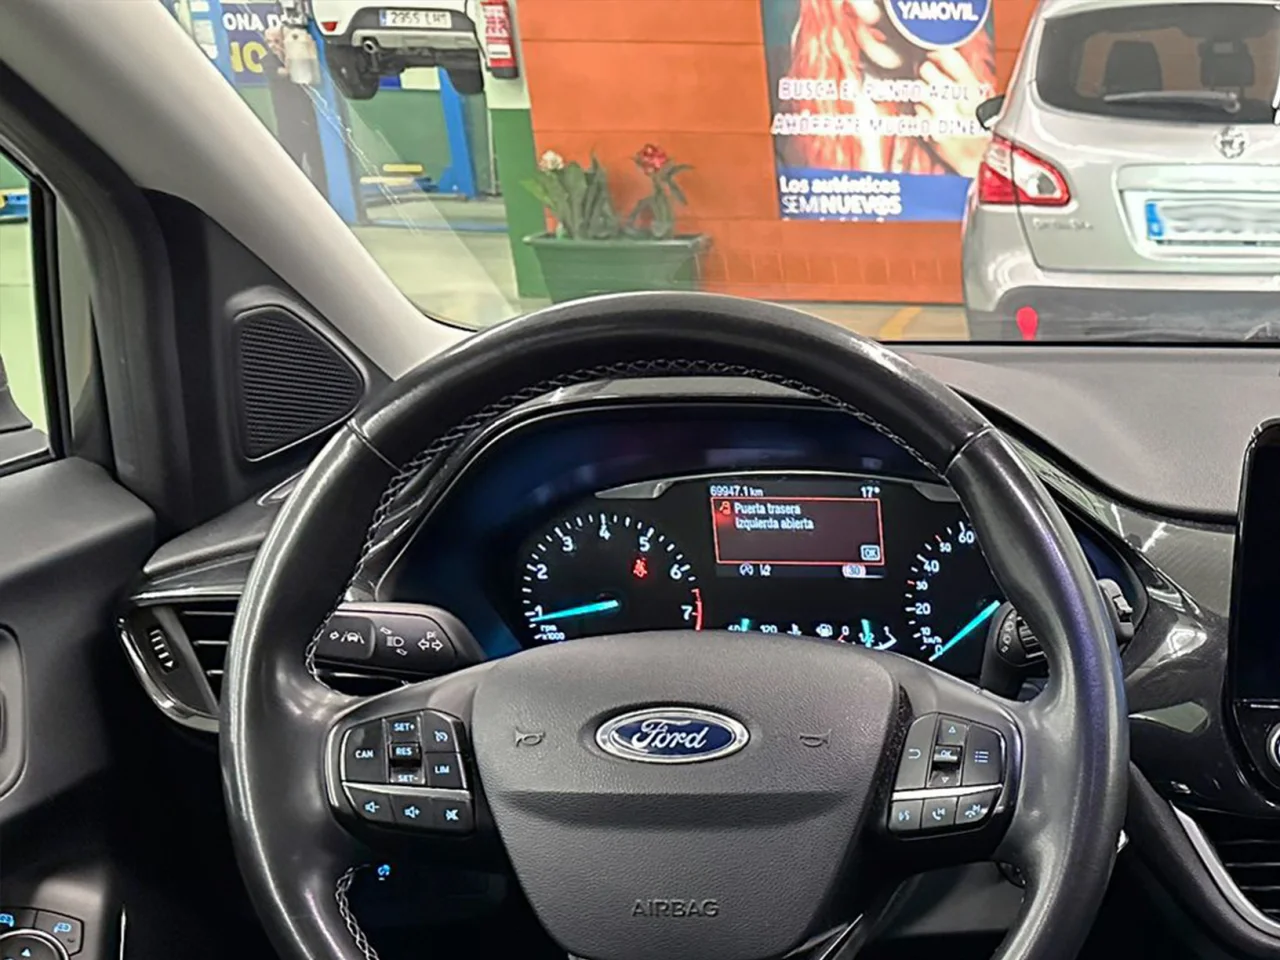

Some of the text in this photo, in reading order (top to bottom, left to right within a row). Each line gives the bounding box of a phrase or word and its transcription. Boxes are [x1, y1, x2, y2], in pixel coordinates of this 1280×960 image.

[898, 1, 979, 21] YAMOVIL
[779, 79, 838, 99] BUSCA
[865, 79, 923, 101] PUNTO
[928, 82, 971, 101] AZUL
[779, 175, 900, 194] Los auténticos
[750, 488, 764, 497] km
[734, 503, 801, 515] Puerta trasera
[735, 518, 814, 531] Izquierda abierta
[600, 526, 611, 540] 4
[959, 531, 975, 543] 60
[562, 537, 574, 551] 3
[639, 537, 650, 551] 5
[939, 543, 952, 553] 50
[537, 564, 548, 579] 2
[670, 566, 682, 580] 6
[924, 560, 940, 573] 40
[916, 581, 929, 591] 30
[681, 606, 692, 620] 7
[915, 602, 931, 614] 20
[542, 632, 565, 640] x1000
[920, 627, 931, 636] 10
[394, 723, 415, 732] SET+
[631, 718, 709, 749] Ford
[355, 750, 374, 758] CAN
[396, 746, 412, 756] RES
[435, 765, 450, 774] LIM
[632, 899, 720, 918] AIRBAG
